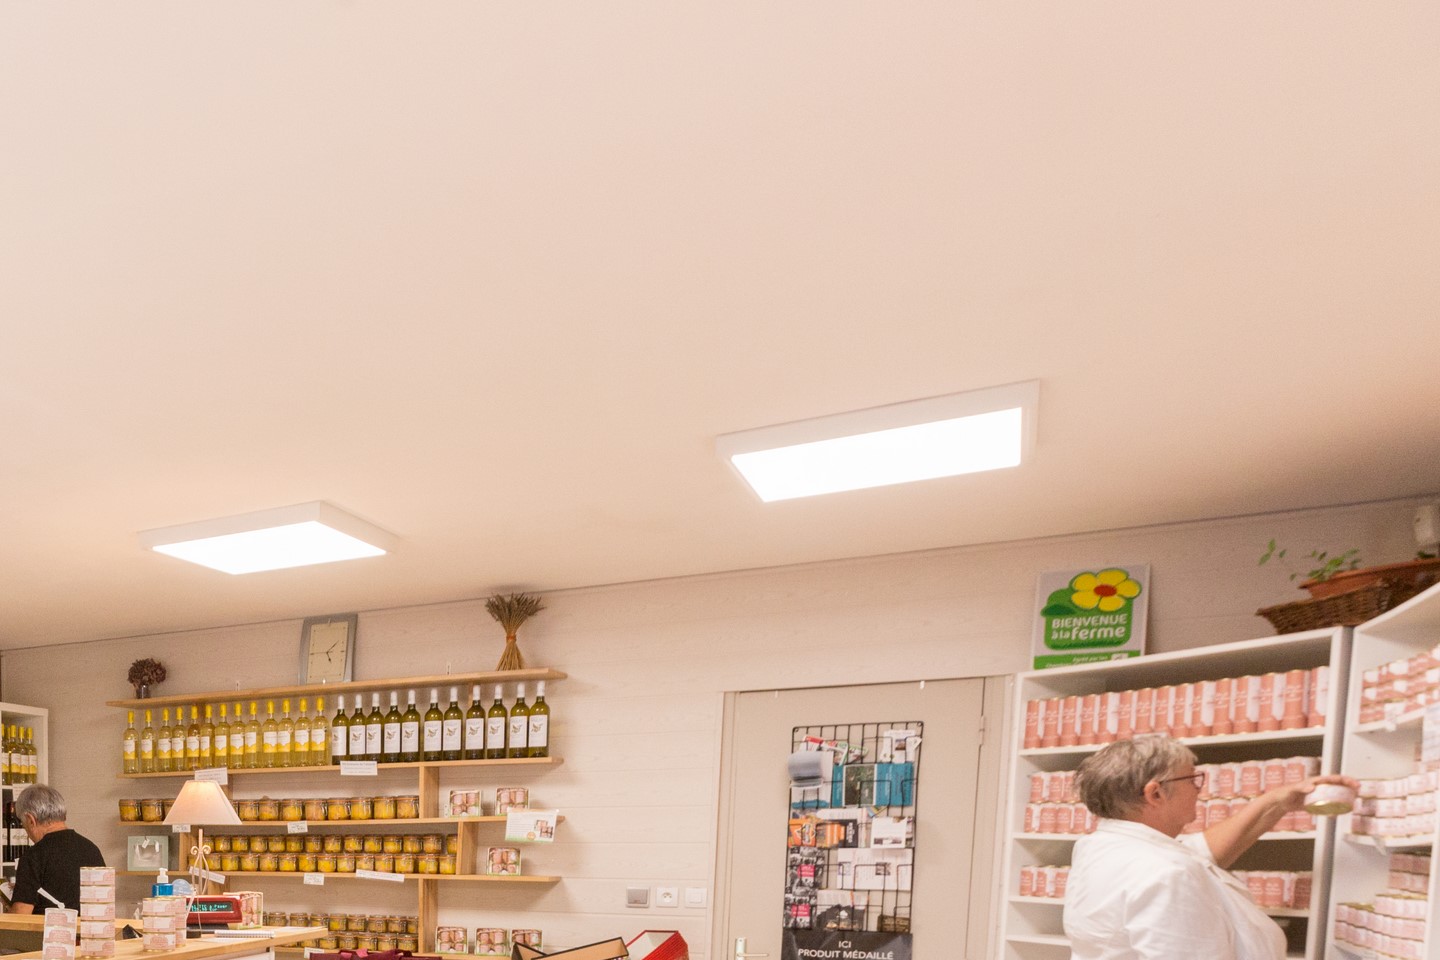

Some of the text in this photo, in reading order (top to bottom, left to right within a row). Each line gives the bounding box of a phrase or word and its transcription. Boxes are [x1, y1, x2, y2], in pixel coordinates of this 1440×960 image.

[1052, 614, 1128, 628] BIENVENUE
[1060, 629, 1070, 640] la
[1071, 626, 1126, 641] ferme
[838, 940, 852, 949] ICI
[798, 948, 894, 960] PRODUIT MÉDAILLÉ
